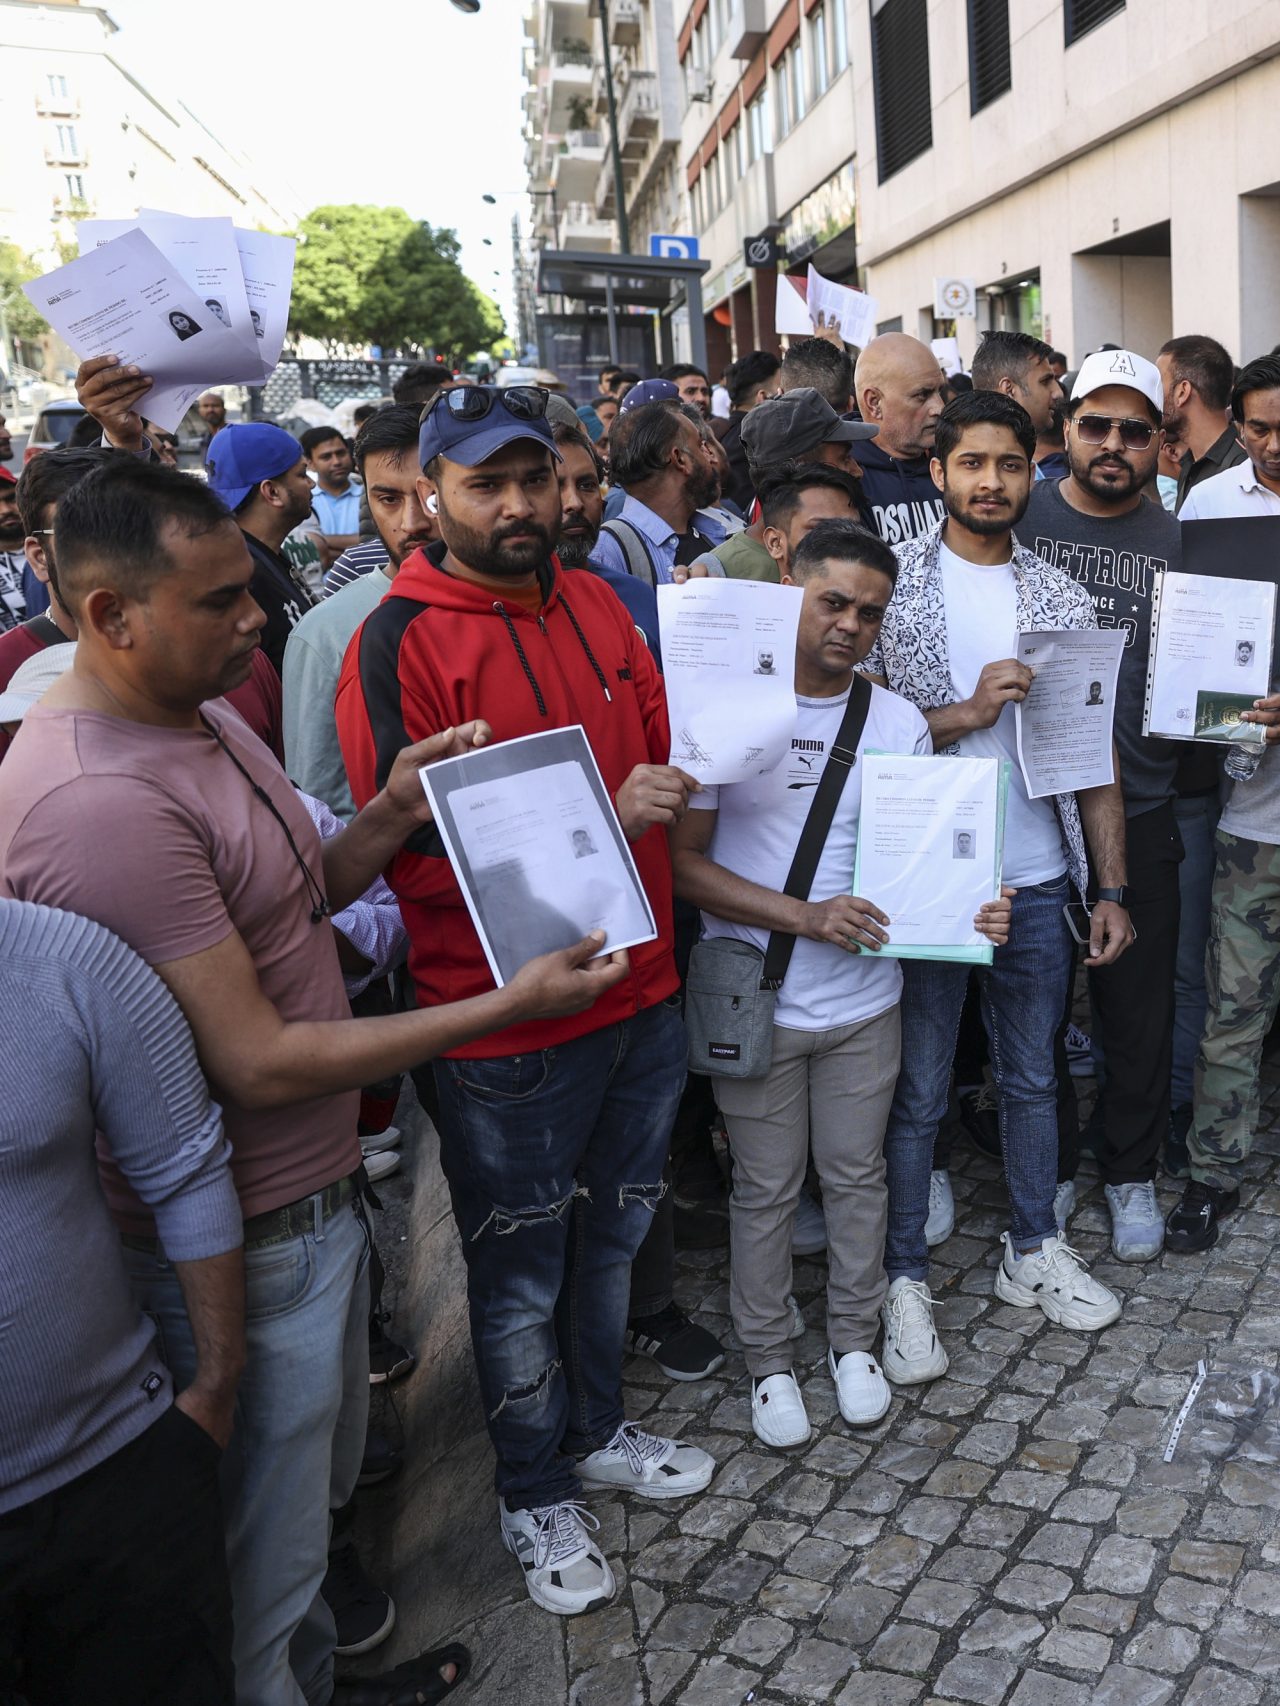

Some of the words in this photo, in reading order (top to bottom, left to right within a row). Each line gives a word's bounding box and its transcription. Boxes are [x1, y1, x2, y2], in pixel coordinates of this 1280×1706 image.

[1109, 352, 1136, 377] A
[1090, 595, 1116, 611] NCE
[791, 738, 824, 752] PUMA
